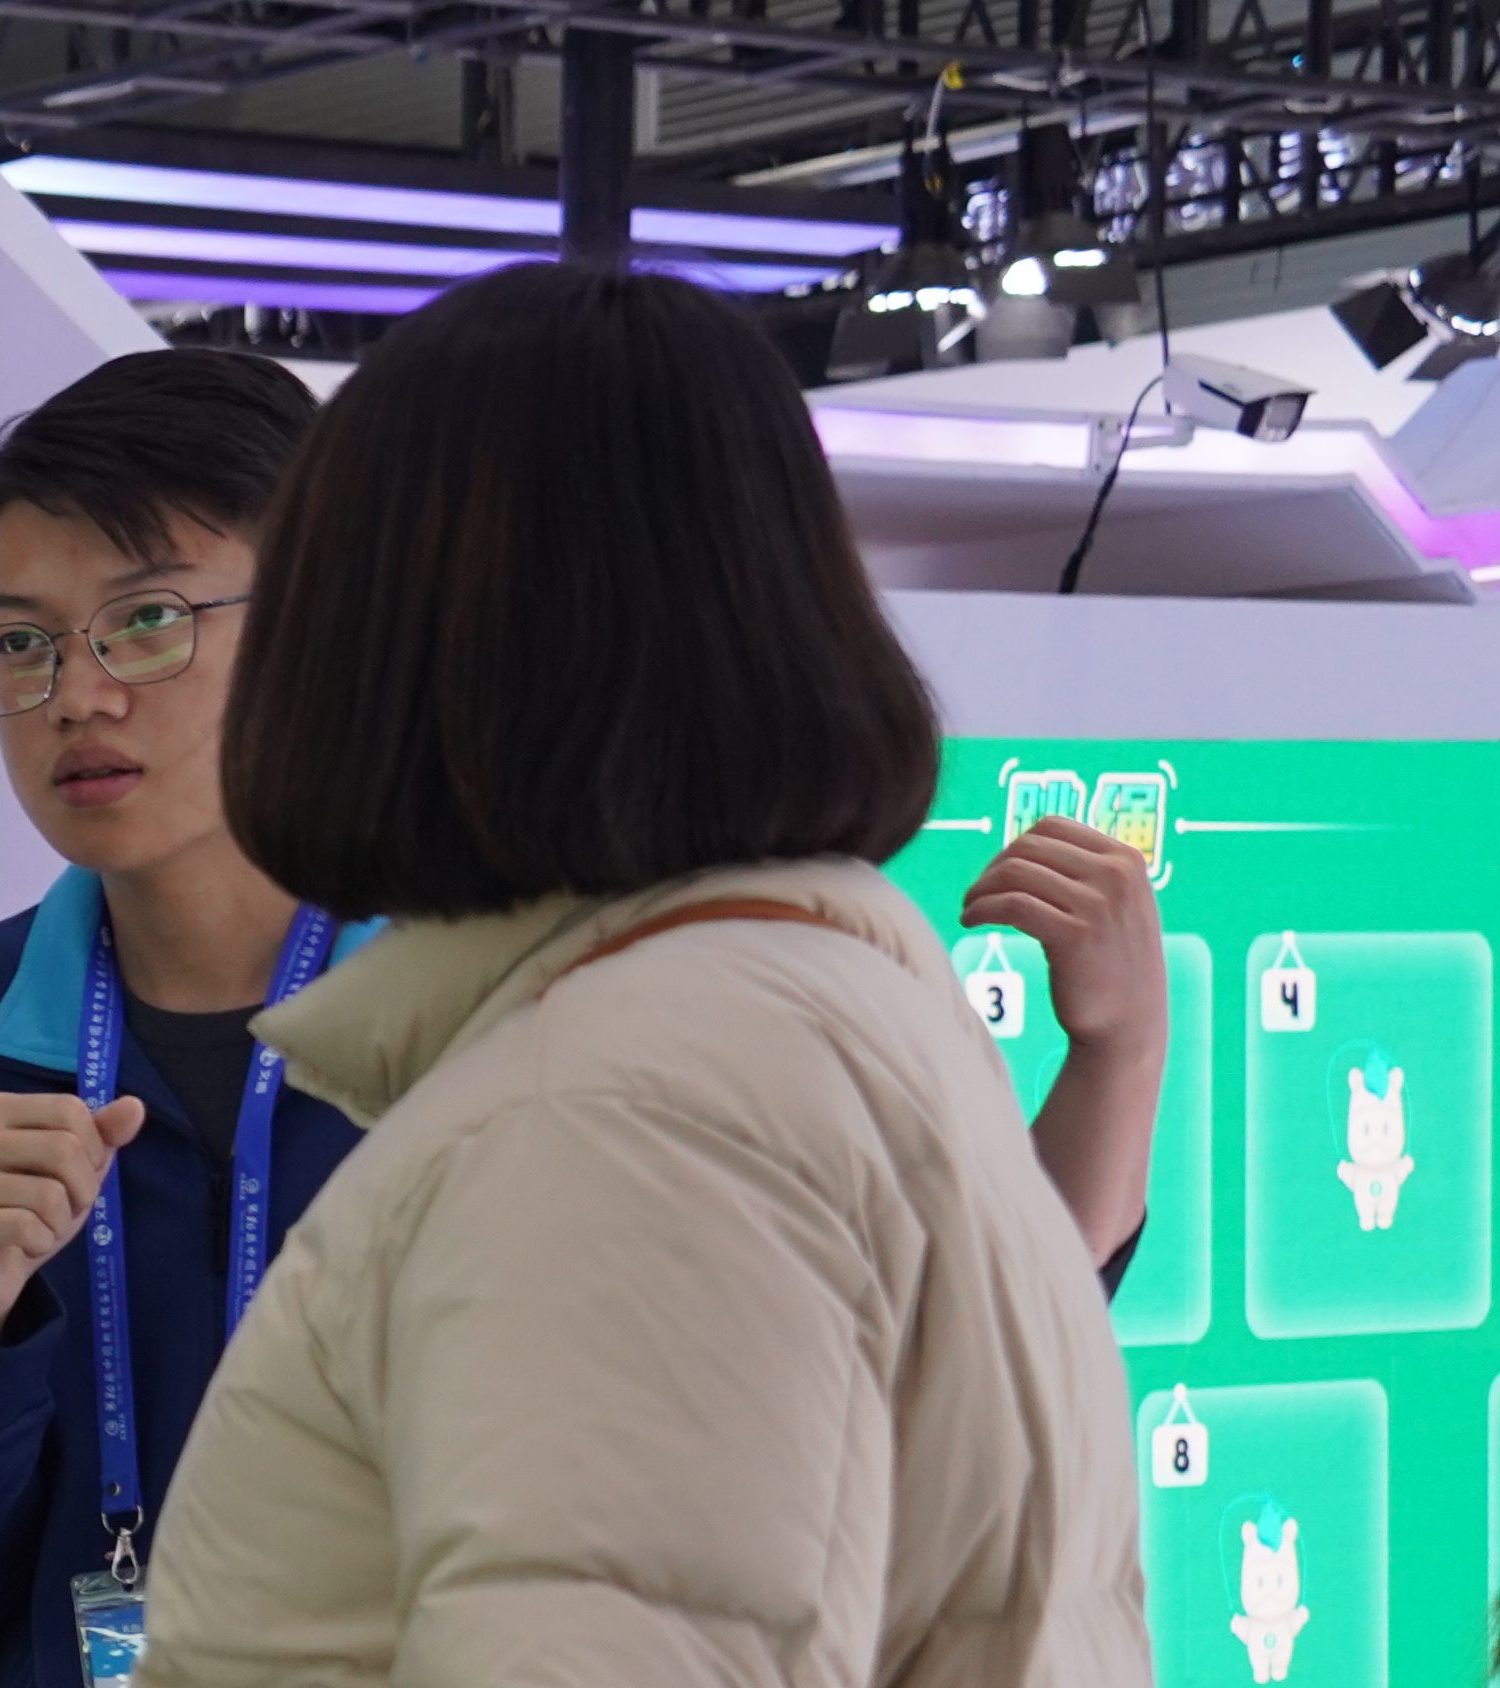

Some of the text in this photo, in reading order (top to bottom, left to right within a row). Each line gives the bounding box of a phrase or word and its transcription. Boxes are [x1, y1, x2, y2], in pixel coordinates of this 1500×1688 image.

[986, 986, 1005, 1022] 3
[1280, 981, 1299, 1017] 4
[1172, 1437, 1190, 1474] 8
